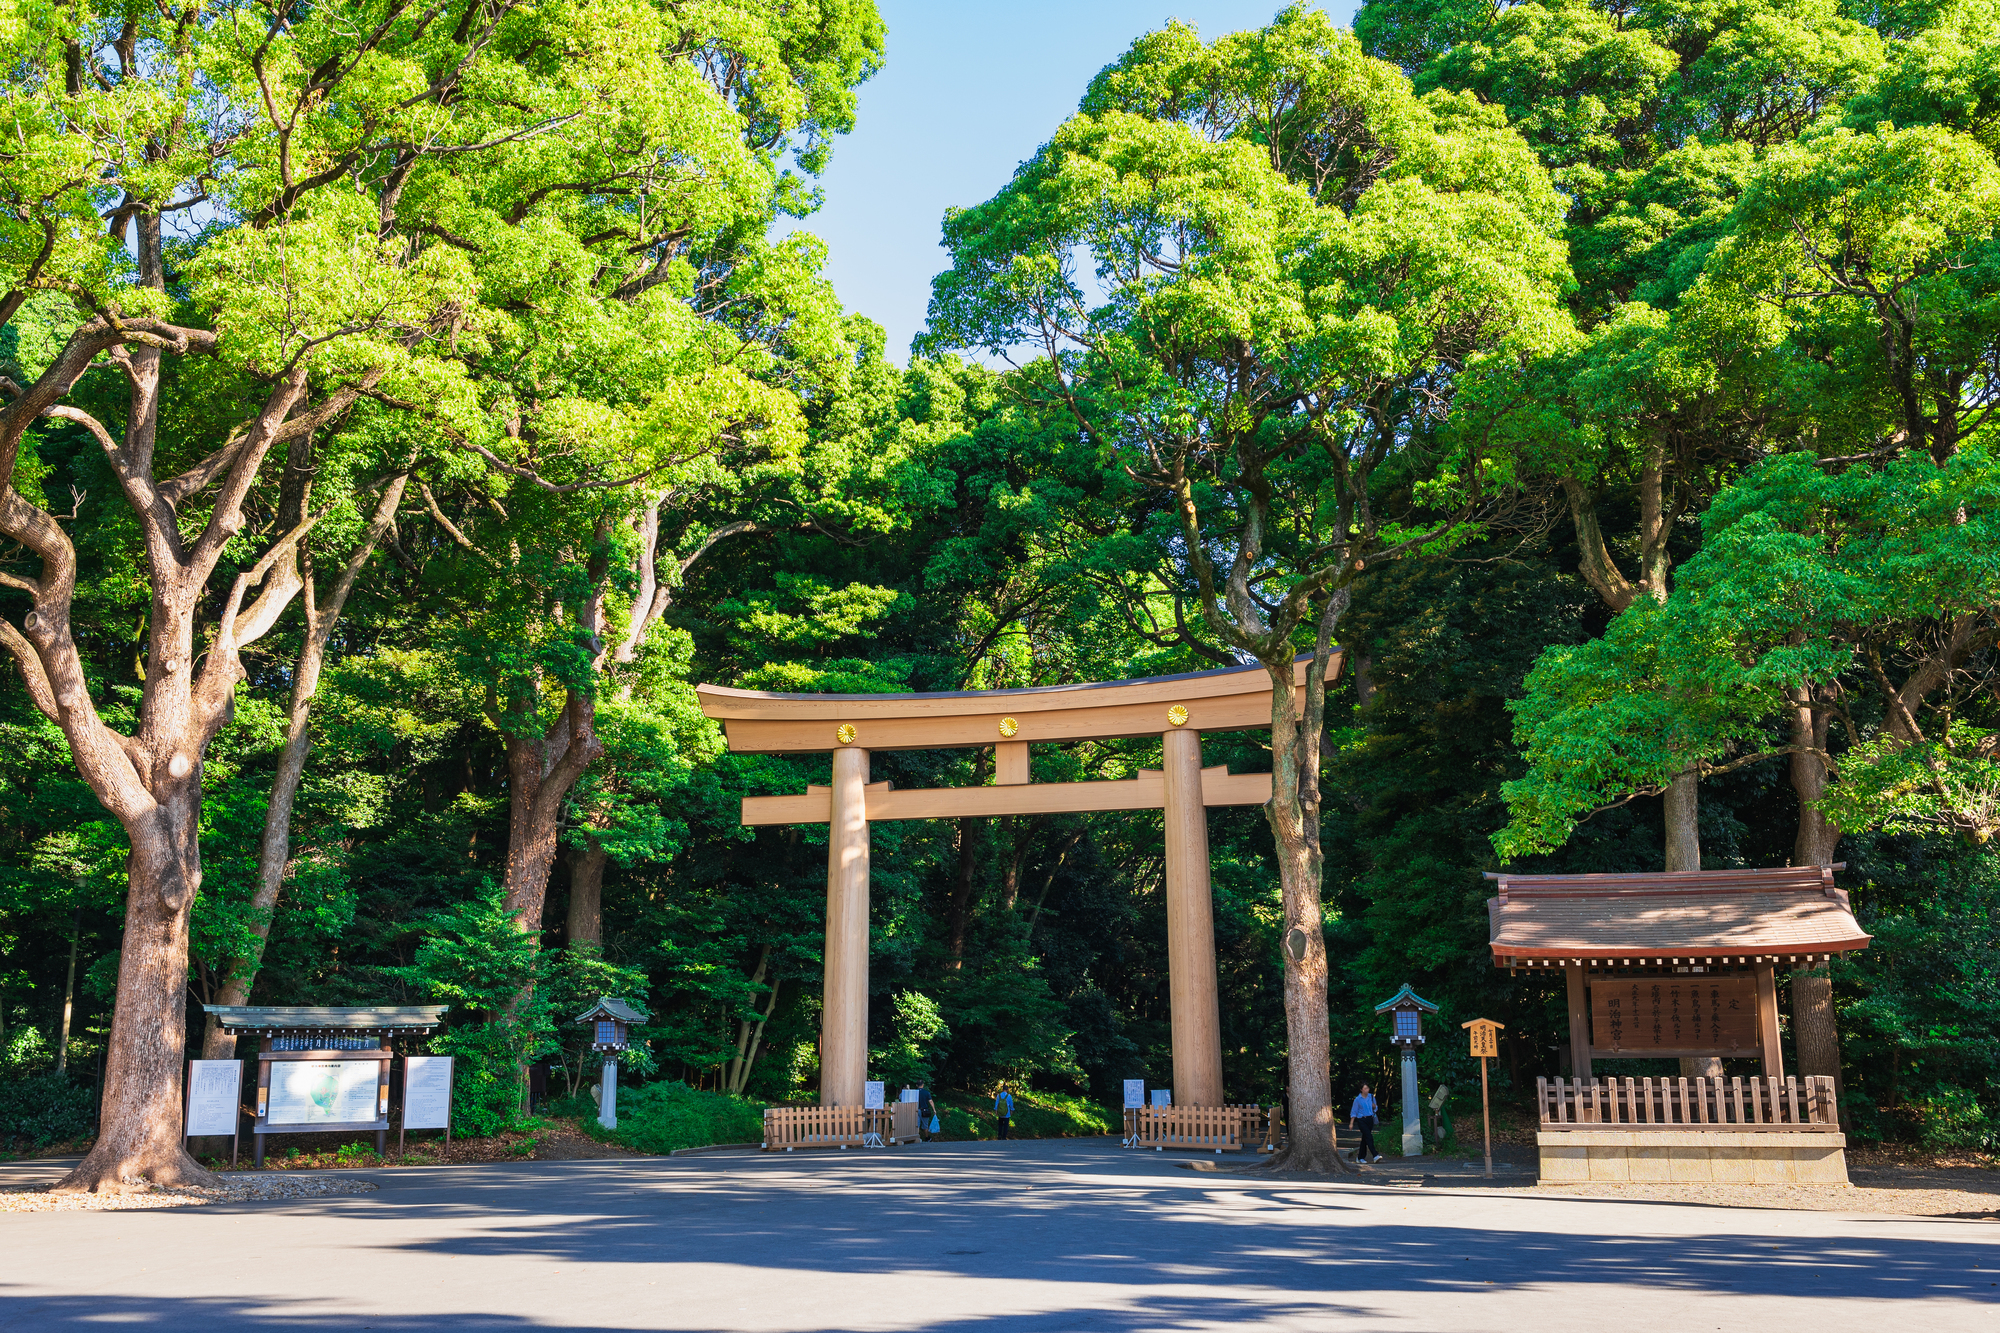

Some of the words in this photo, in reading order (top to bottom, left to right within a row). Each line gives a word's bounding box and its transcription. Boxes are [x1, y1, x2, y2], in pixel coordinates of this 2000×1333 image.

[1608, 999, 1622, 1040] 明治神宮
[1651, 984, 1662, 1045] 右境内ニ於テ禁止ス
[1670, 986, 1681, 1040] 一竹木ヲ伐ルコト
[1729, 999, 1740, 1010] 定
